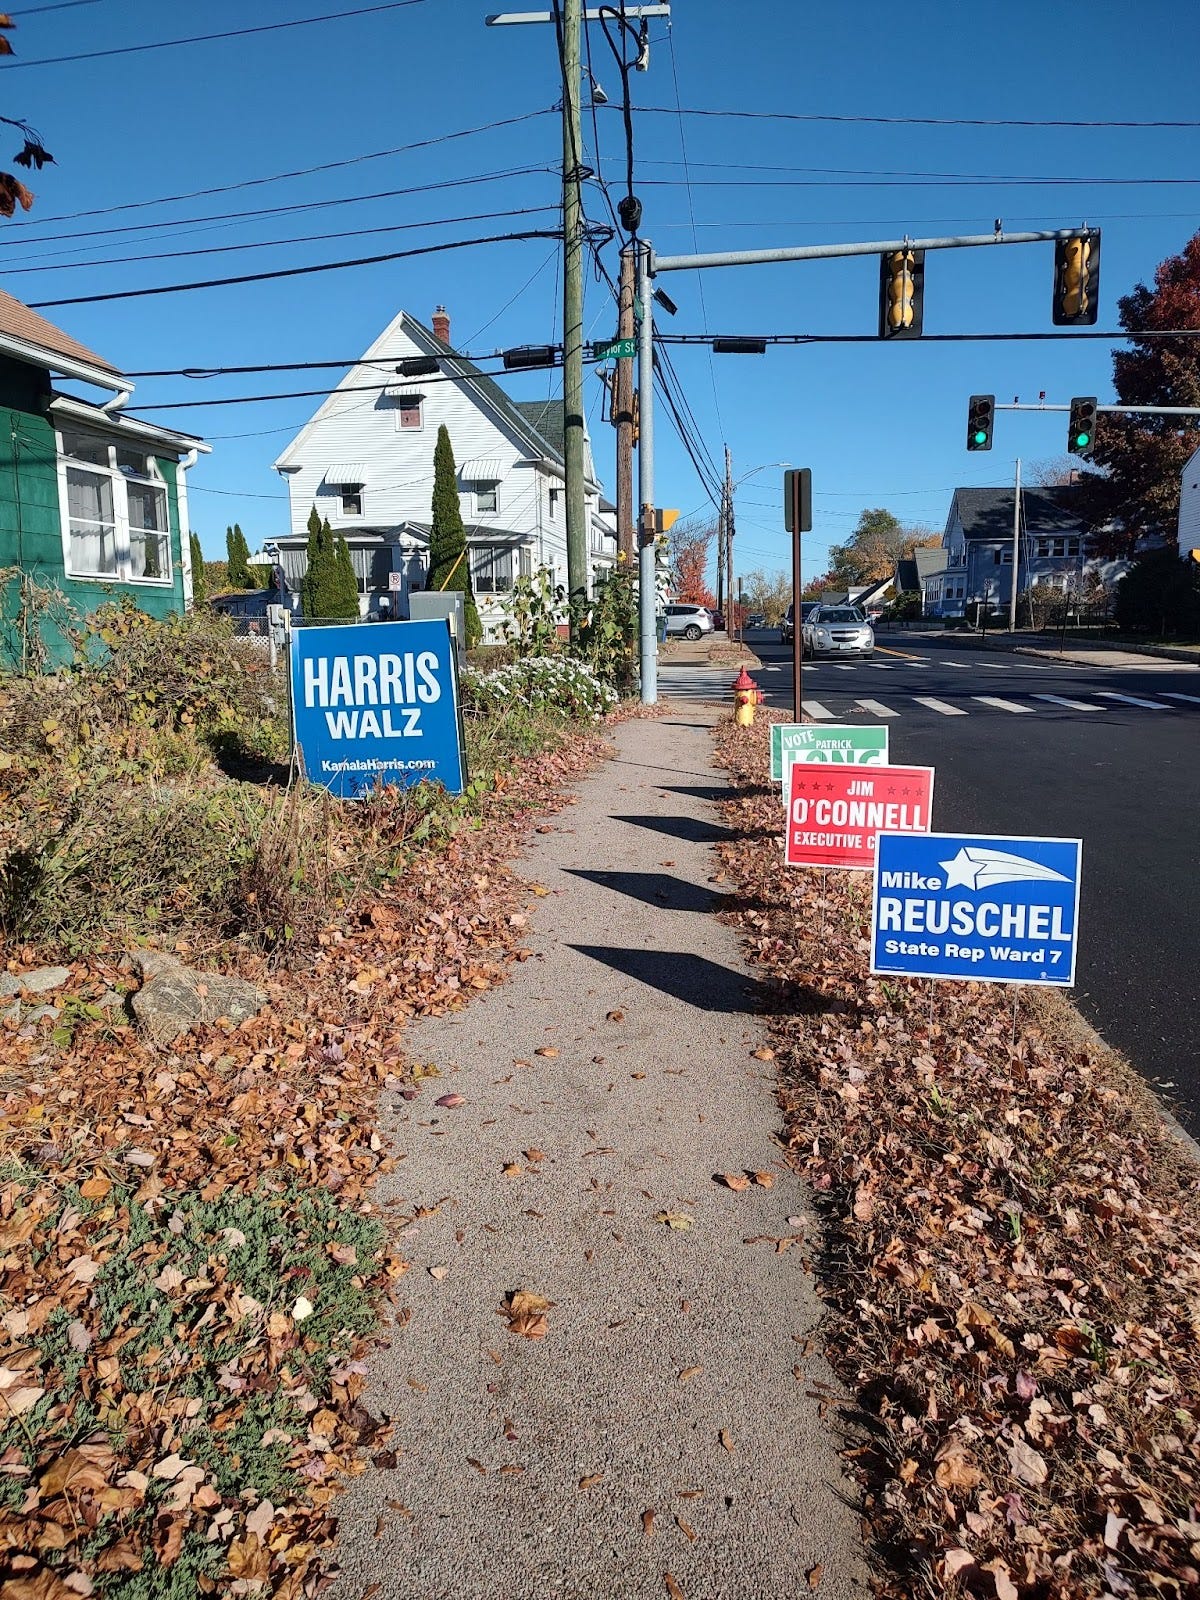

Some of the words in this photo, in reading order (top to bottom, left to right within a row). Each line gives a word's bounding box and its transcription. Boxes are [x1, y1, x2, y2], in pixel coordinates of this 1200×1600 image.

[596, 343, 621, 357] Taylor
[625, 342, 635, 353] St
[304, 651, 441, 708] HARRIS
[325, 708, 423, 740] WALZ
[784, 730, 815, 749] VOTE
[816, 739, 852, 749] PATRICK
[321, 758, 436, 772] KamalaHarris.com
[846, 780, 874, 797] JIM
[792, 797, 926, 832] O'CONNELL
[794, 831, 863, 849] EXECUTIVE
[881, 871, 942, 891] Mike
[879, 896, 1072, 941] REUSCHEL
[884, 940, 940, 957] State
[944, 942, 985, 963] Rep
[990, 946, 1045, 963] Ward
[1049, 950, 1063, 964] 7
